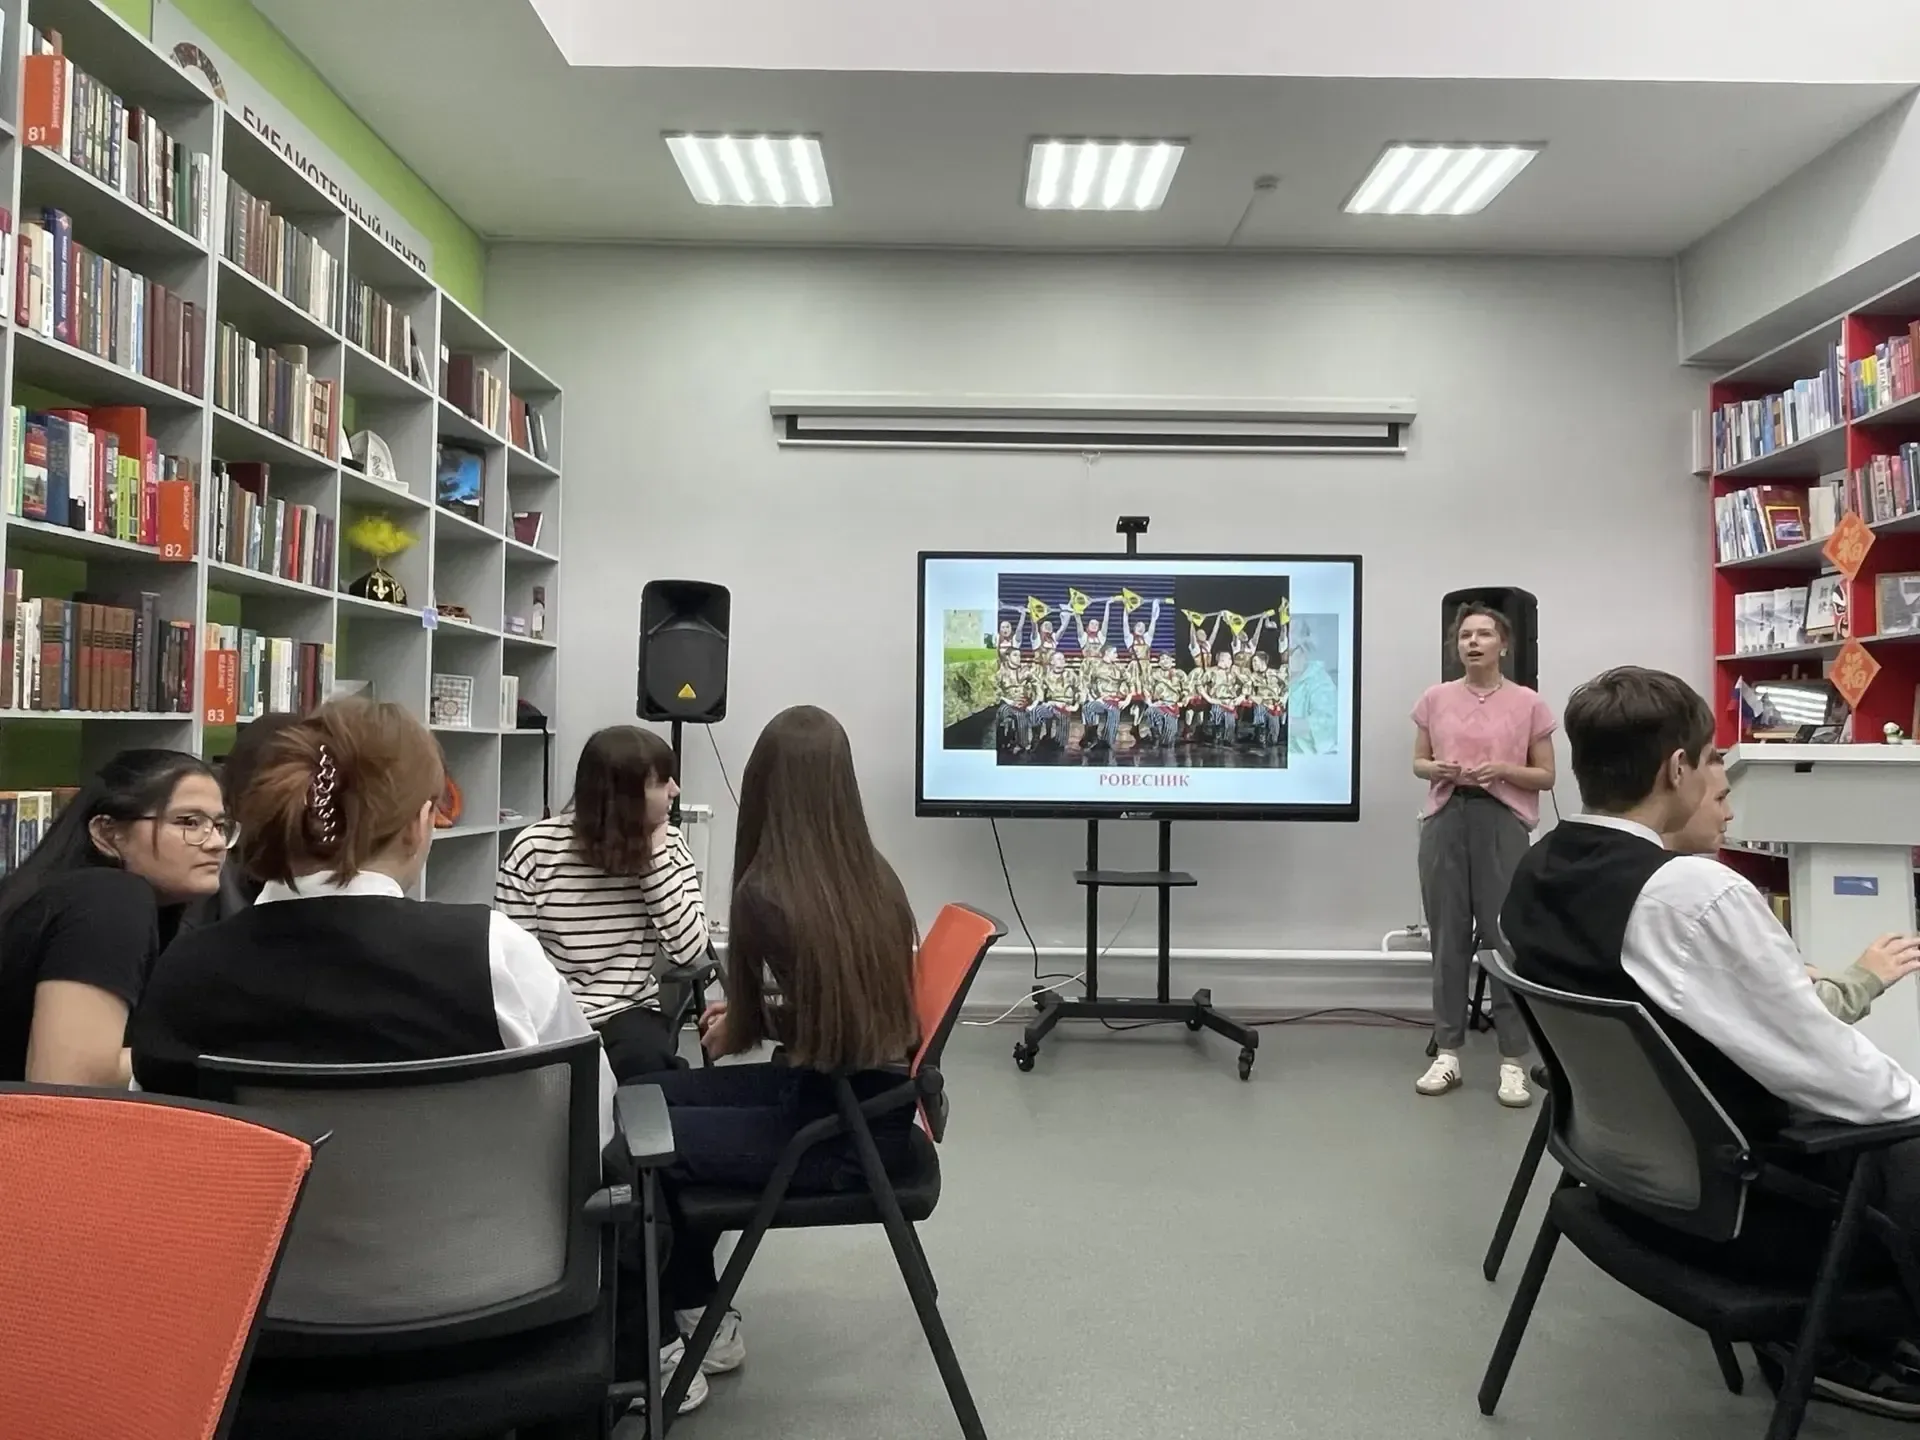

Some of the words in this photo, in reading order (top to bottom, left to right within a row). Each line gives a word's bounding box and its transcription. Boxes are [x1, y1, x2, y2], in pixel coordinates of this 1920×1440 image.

[28, 126, 47, 142] 81
[164, 543, 183, 557] 82
[207, 709, 225, 722] 83
[1099, 772, 1190, 787] РОВЕСНИК
